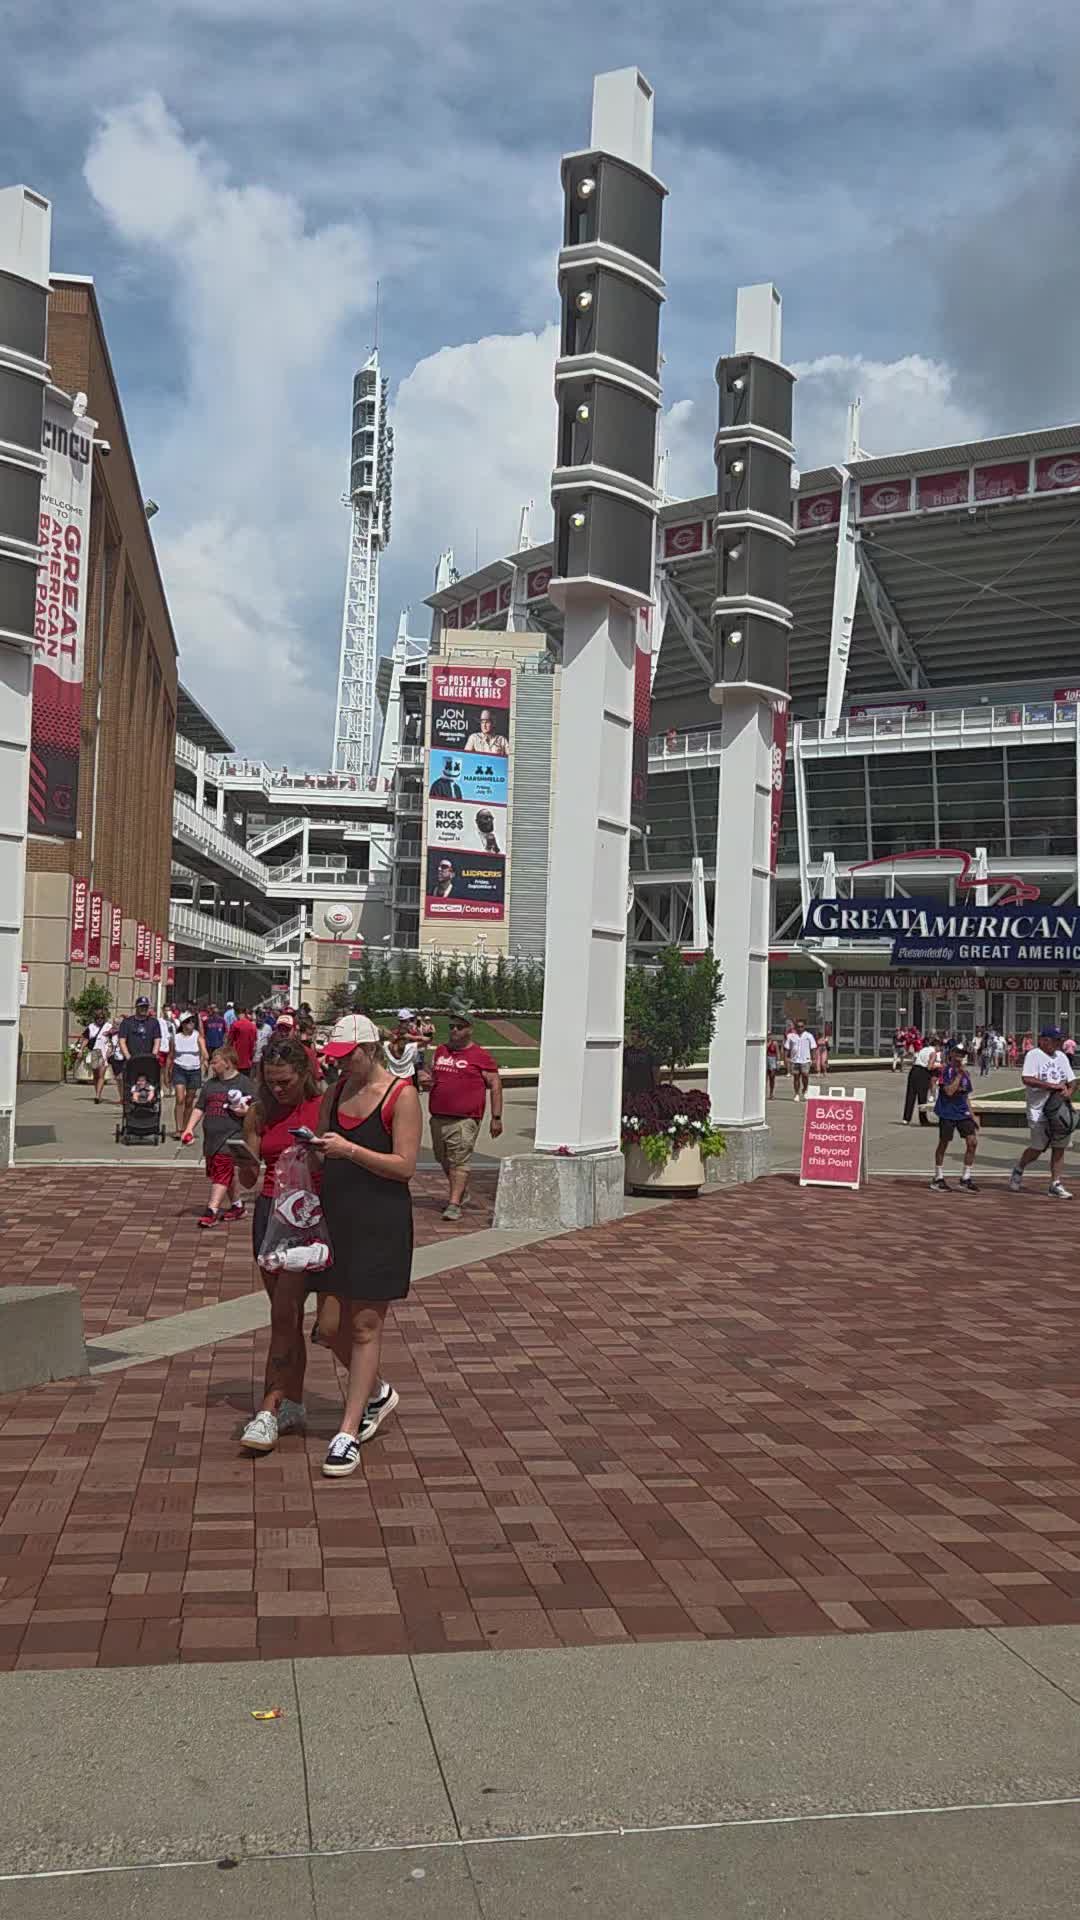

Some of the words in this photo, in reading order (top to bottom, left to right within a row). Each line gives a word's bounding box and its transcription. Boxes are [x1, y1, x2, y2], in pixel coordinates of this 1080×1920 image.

[41, 494, 84, 517] WELCOME
[56, 508, 69, 519] TO
[47, 519, 62, 657] AMERICAN
[60, 524, 81, 665] GREAT
[448, 675, 493, 688] POST-GAME
[439, 685, 472, 698] CONCERT
[474, 687, 502, 699] SERIES
[440, 709, 465, 720] JON
[436, 720, 469, 731] PARDI
[435, 810, 463, 819] RICK
[435, 820, 464, 830] RO$$
[74, 882, 86, 931] TICKETS
[91, 896, 101, 939] TICKETS
[813, 903, 917, 931] GREAT
[905, 910, 1079, 939] AMERICAN
[112, 908, 121, 946] TICKETS
[137, 924, 145, 957] TICKETS
[143, 930, 151, 960] TICKETS
[898, 944, 942, 959] Presented
[941, 946, 954, 960] by
[959, 944, 1012, 959] GREAT
[847, 975, 891, 988] HAMILTON
[893, 976, 928, 988] COUNTY
[930, 976, 979, 989] WELCOMES
[984, 977, 1002, 990] YOU
[1023, 978, 1040, 990] 100
[1042, 978, 1059, 990] JOE
[815, 1107, 854, 1121] BAGS
[810, 1121, 845, 1131] Subject
[847, 1123, 857, 1132] to
[808, 1132, 857, 1143] Inspection
[814, 1146, 850, 1157] Beyond
[808, 1157, 826, 1166] this
[828, 1158, 853, 1168] Point
